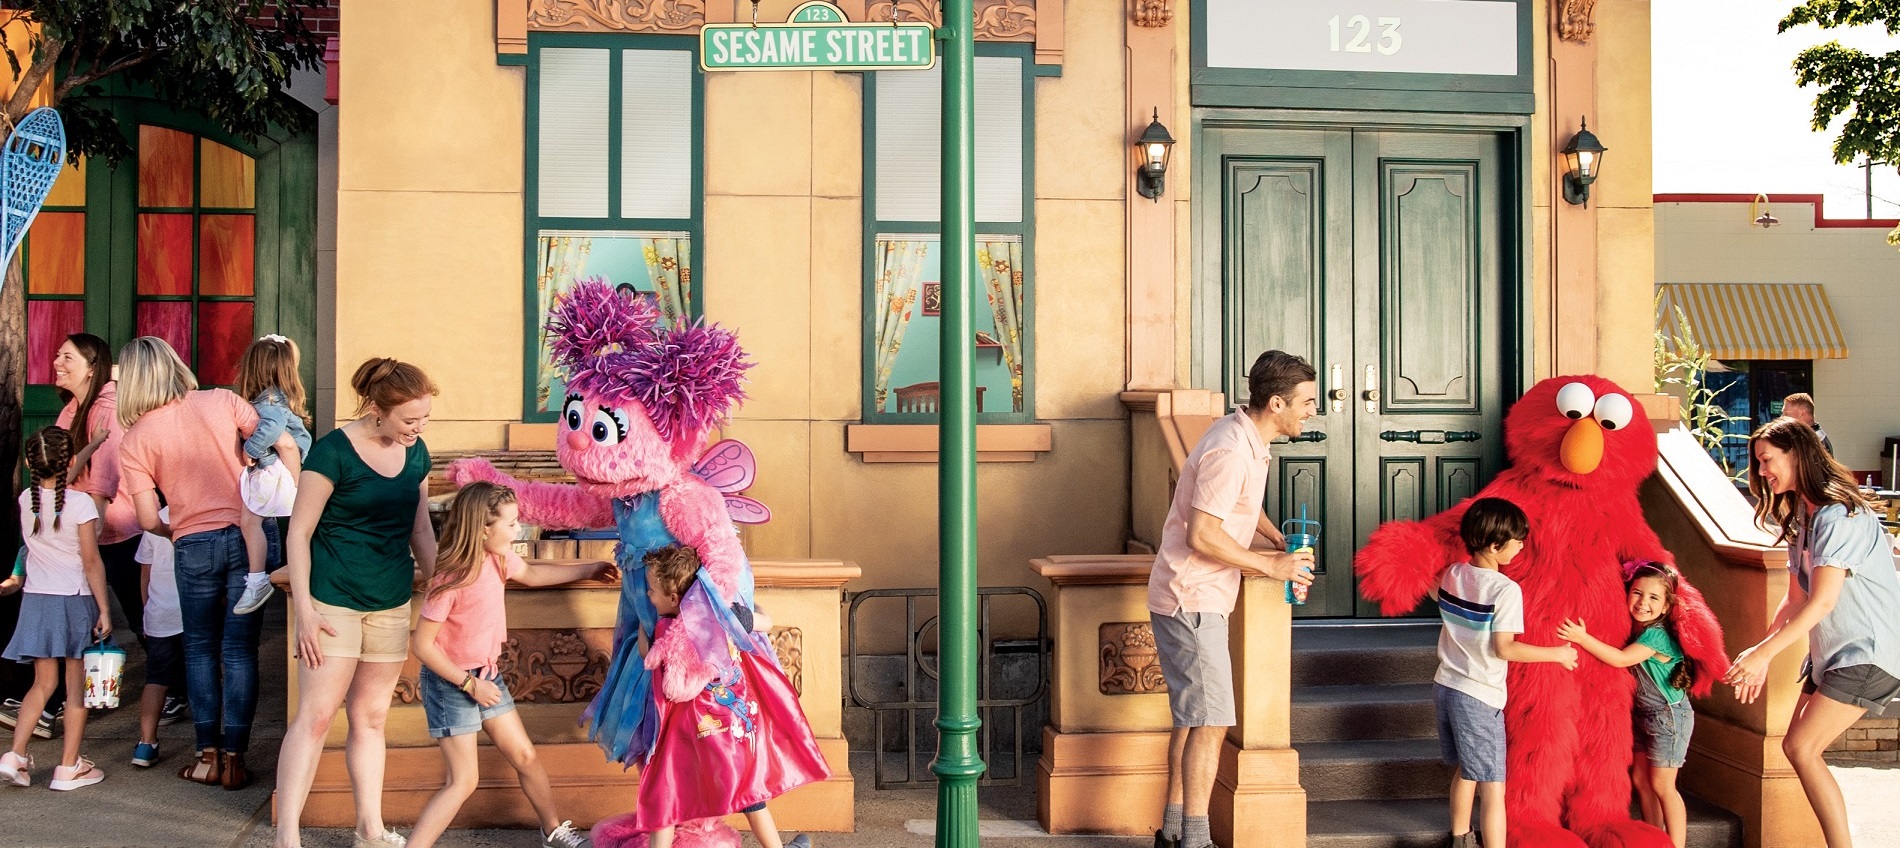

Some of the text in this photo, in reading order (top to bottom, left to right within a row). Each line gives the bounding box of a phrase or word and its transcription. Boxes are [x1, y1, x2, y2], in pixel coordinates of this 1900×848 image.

[806, 9, 829, 21] 123
[713, 31, 818, 63] SESAME
[1328, 15, 1403, 56] 123
